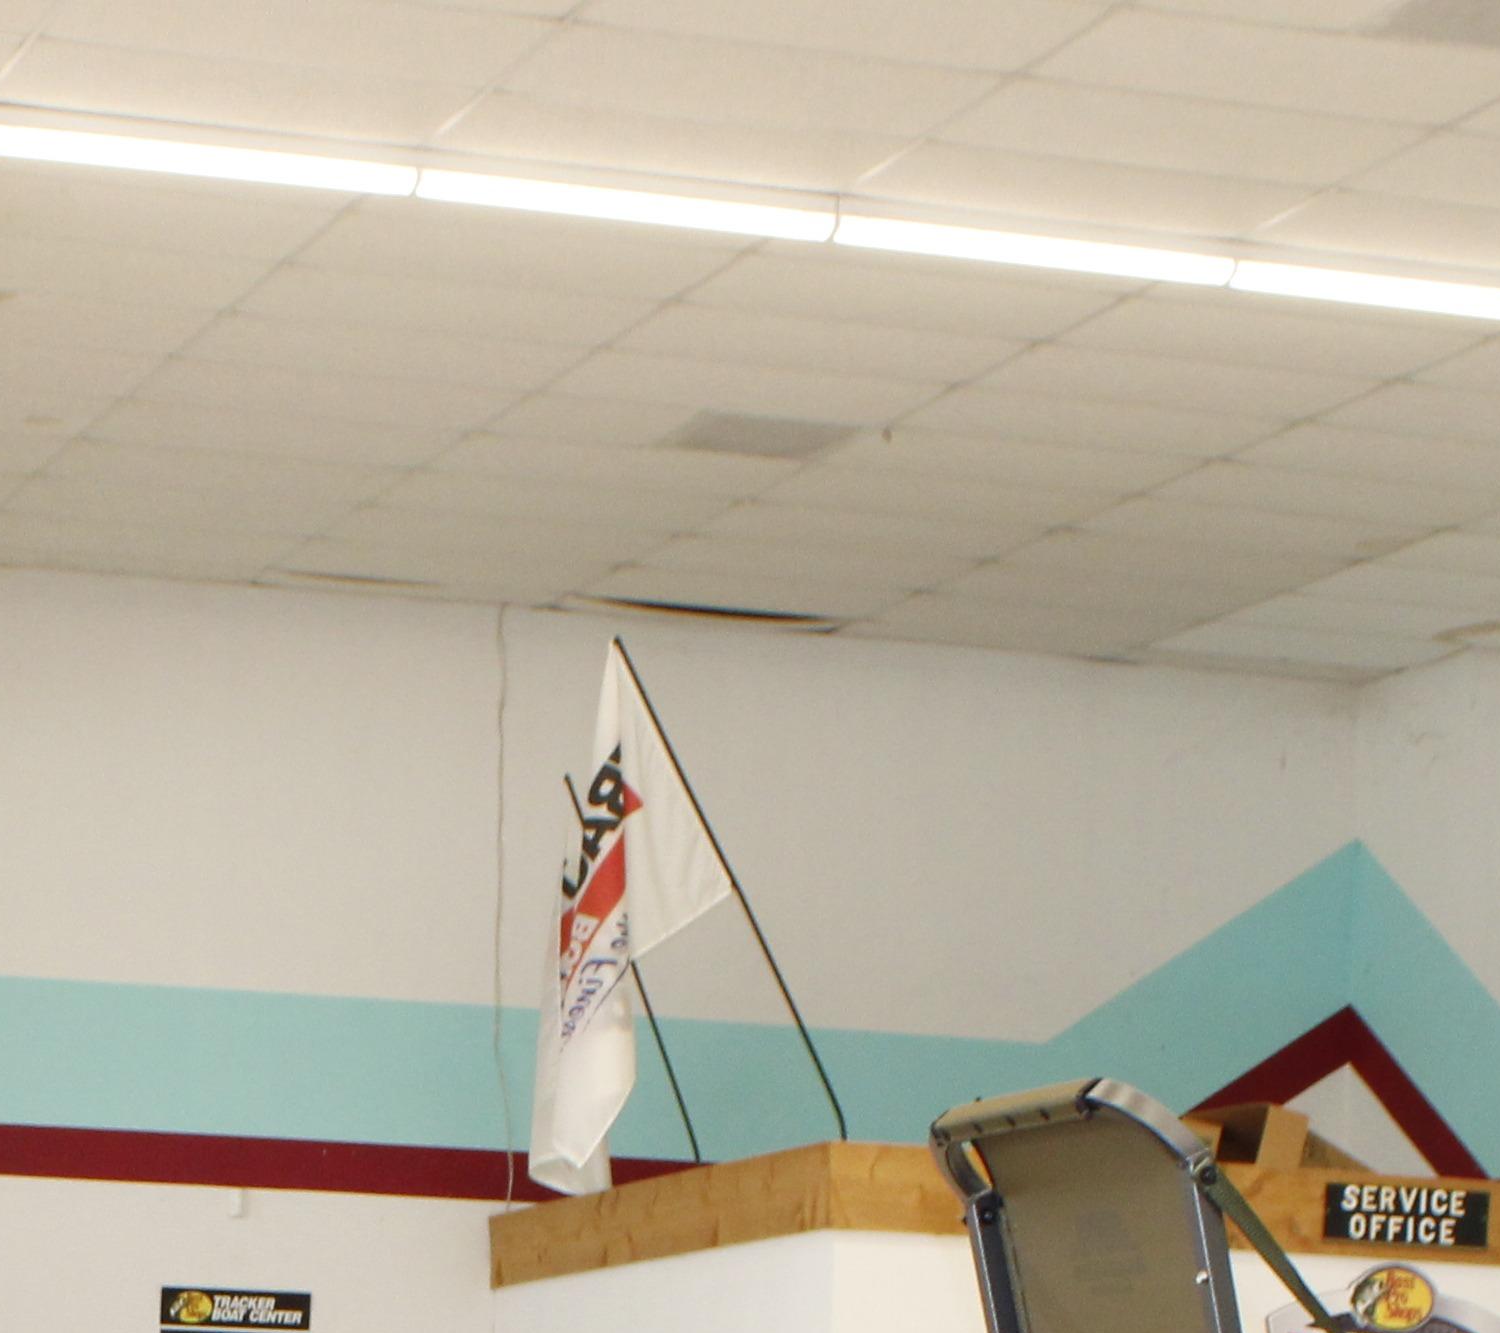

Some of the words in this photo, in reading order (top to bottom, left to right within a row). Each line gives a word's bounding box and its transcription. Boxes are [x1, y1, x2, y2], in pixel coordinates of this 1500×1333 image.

[1340, 1184, 1467, 1218] SERVICE
[1349, 1216, 1457, 1246] OFFICE
[213, 1295, 276, 1310] TRACKER
[211, 1308, 248, 1321] BOAT
[249, 1310, 303, 1326] CENTER
